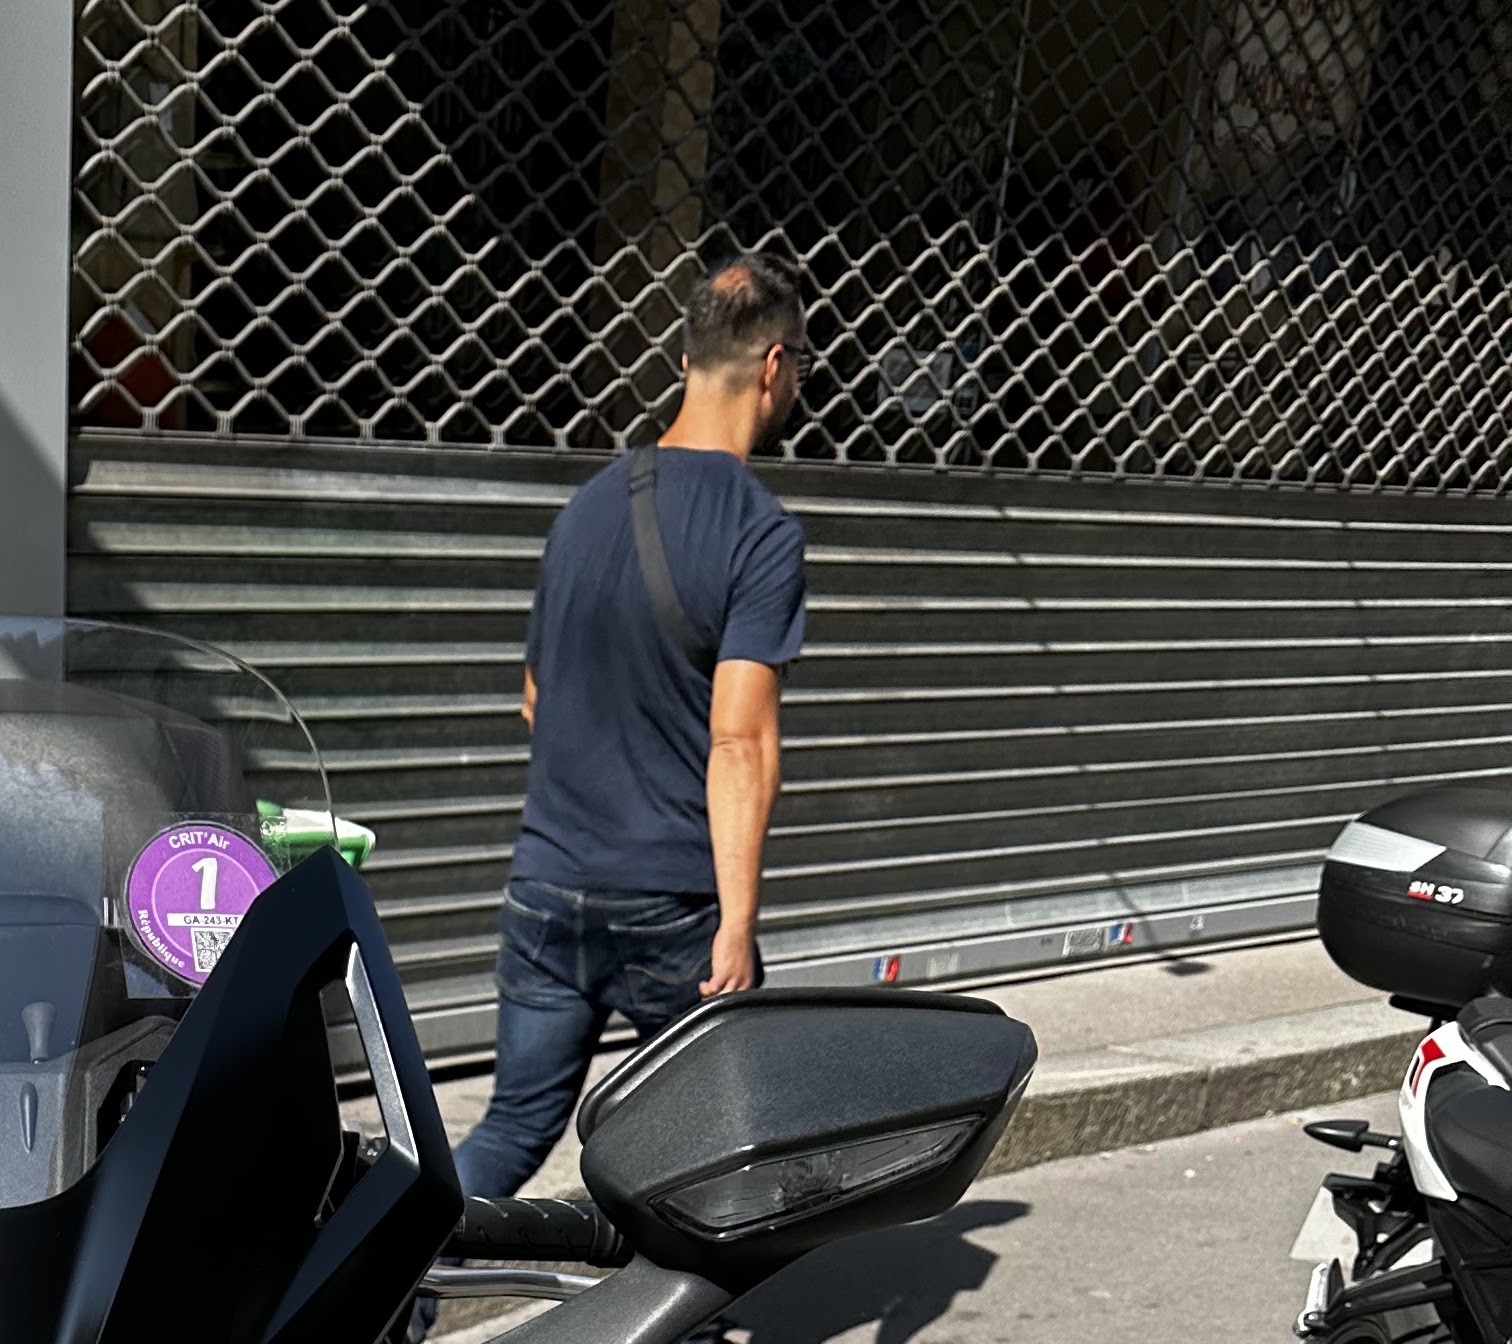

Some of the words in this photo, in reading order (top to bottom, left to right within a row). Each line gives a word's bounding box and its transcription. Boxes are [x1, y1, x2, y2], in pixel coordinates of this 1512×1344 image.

[168, 831, 230, 850] CRIT'Air
[192, 857, 218, 910] 1
[1434, 885, 1465, 904] 37
[183, 915, 239, 925] GA-243-KT
[138, 909, 186, 968] République
